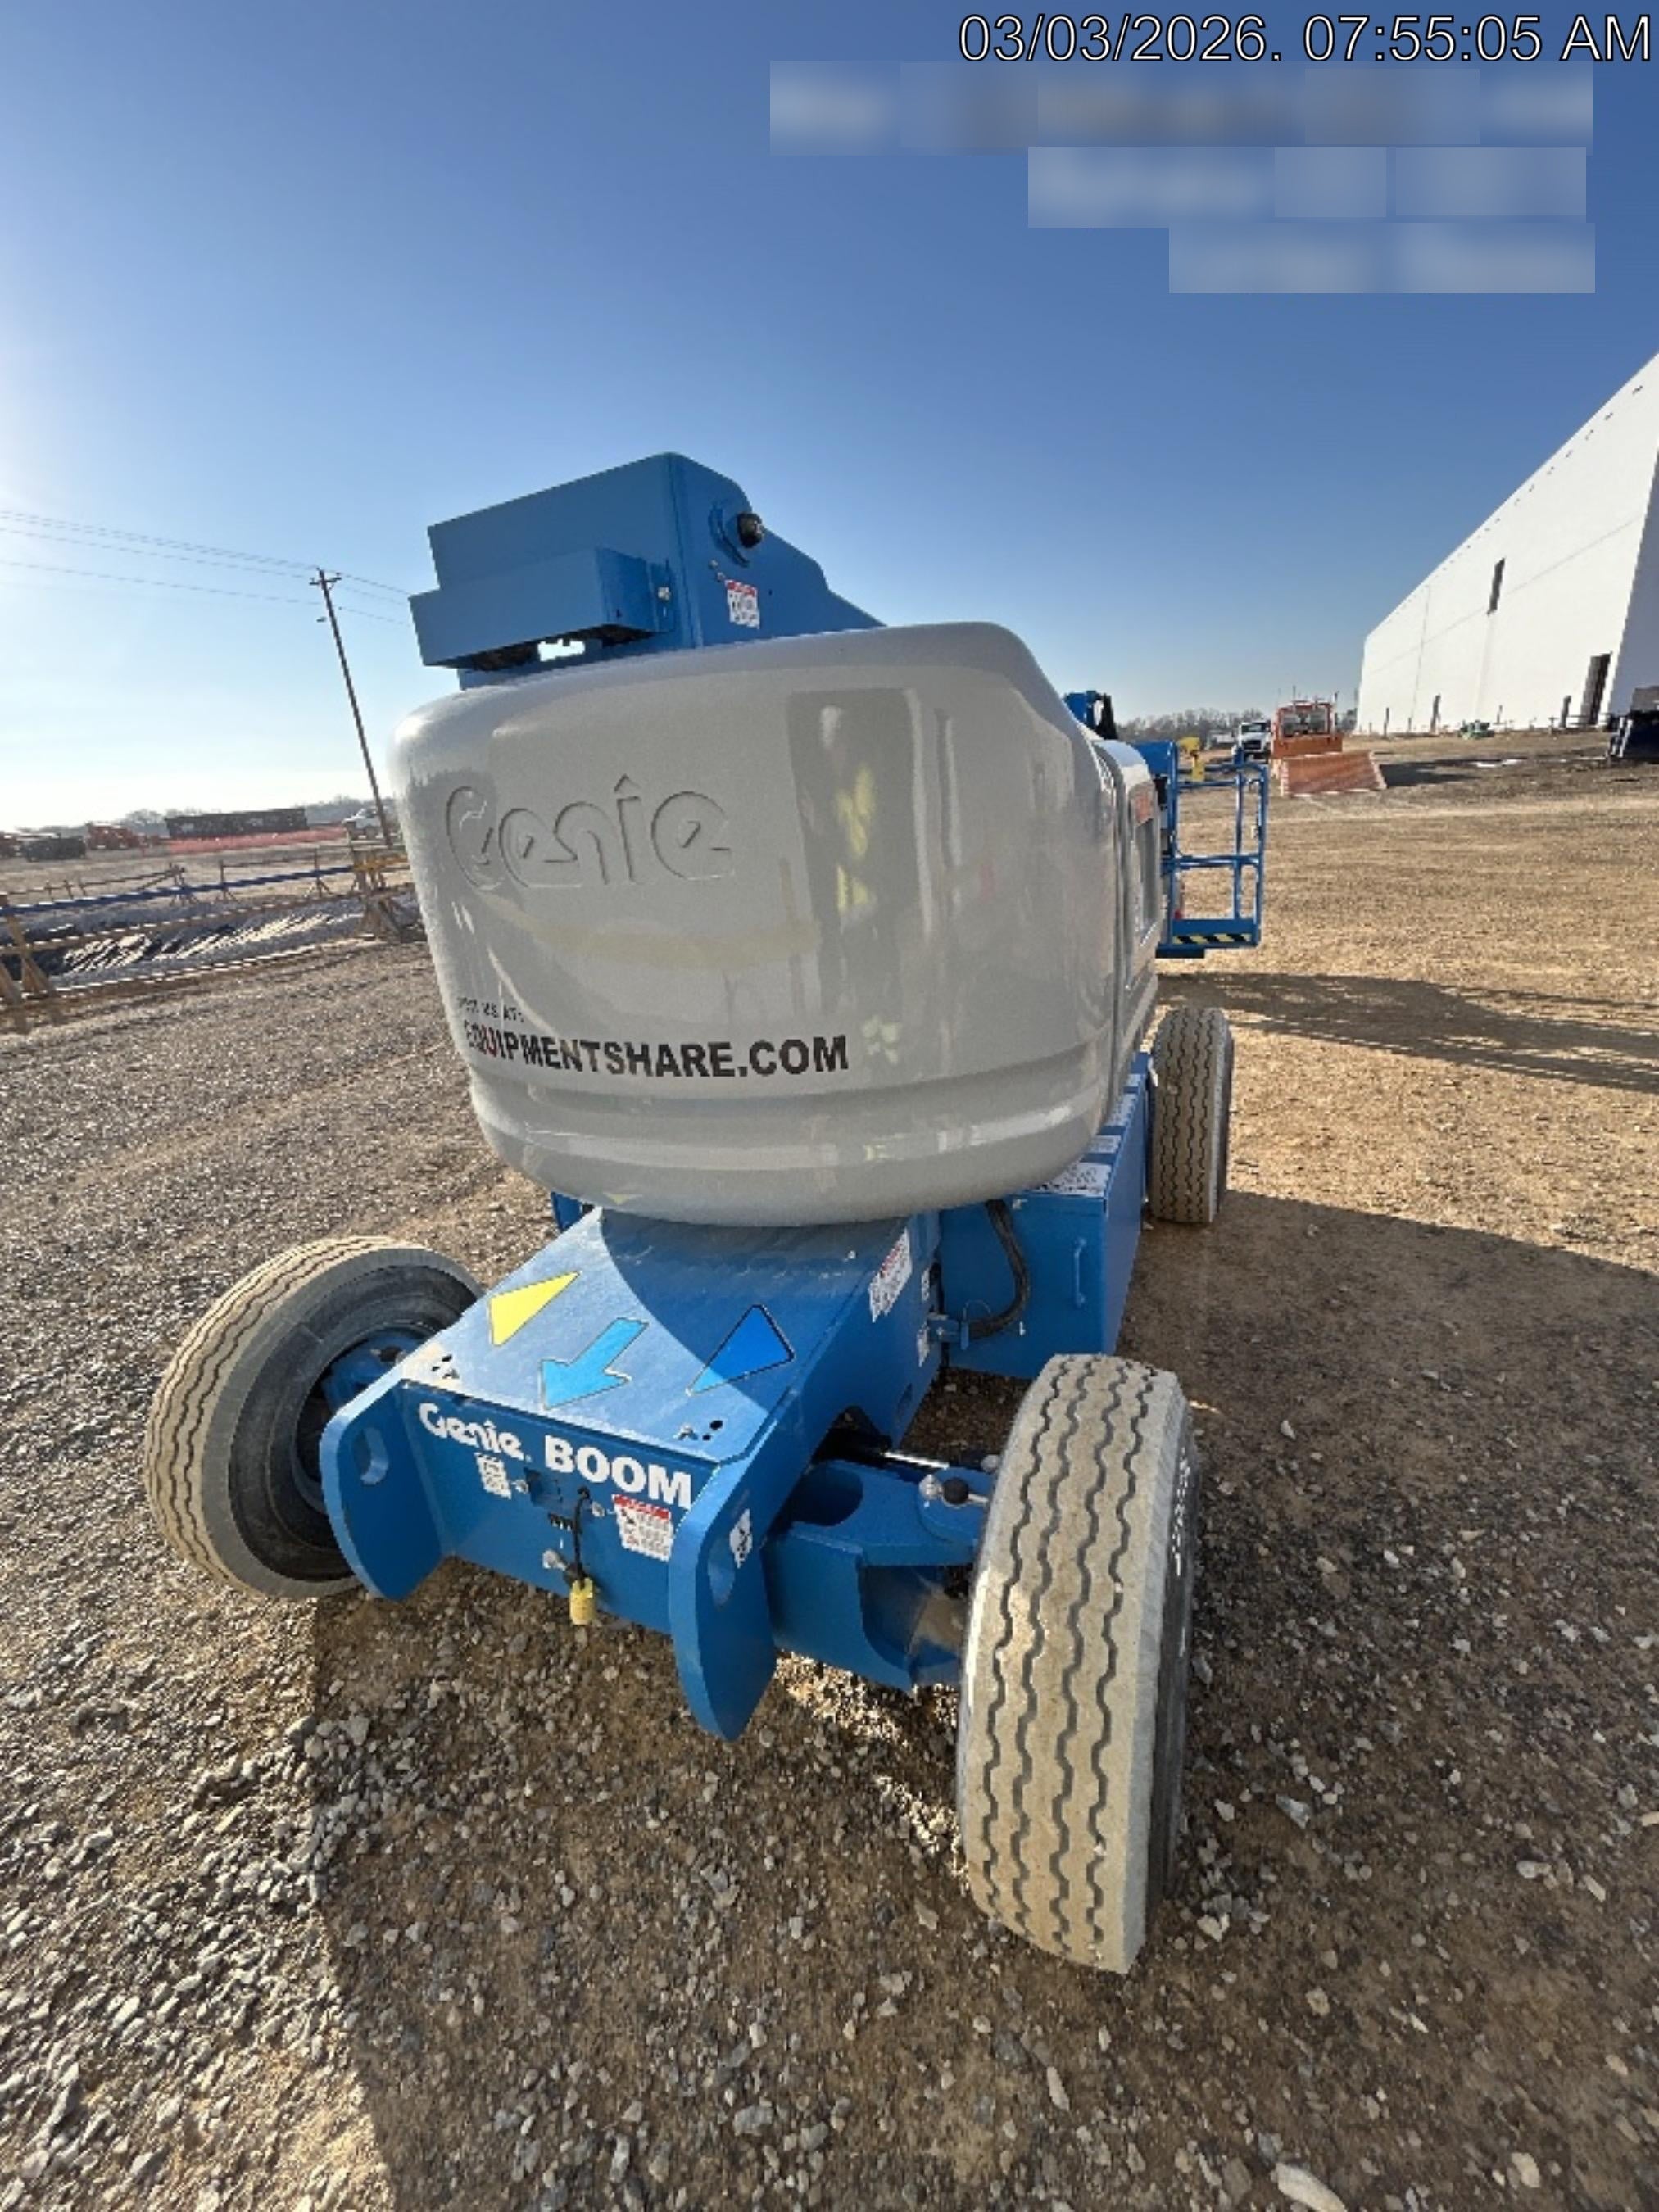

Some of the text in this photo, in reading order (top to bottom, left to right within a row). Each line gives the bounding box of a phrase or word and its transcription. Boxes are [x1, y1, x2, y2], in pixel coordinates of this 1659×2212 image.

[446, 774, 734, 891] Genie
[463, 1020, 849, 1077] EQUIPMENTSHARE.COM
[419, 1403, 524, 1461] Genie
[545, 1435, 692, 1509] BOOM
